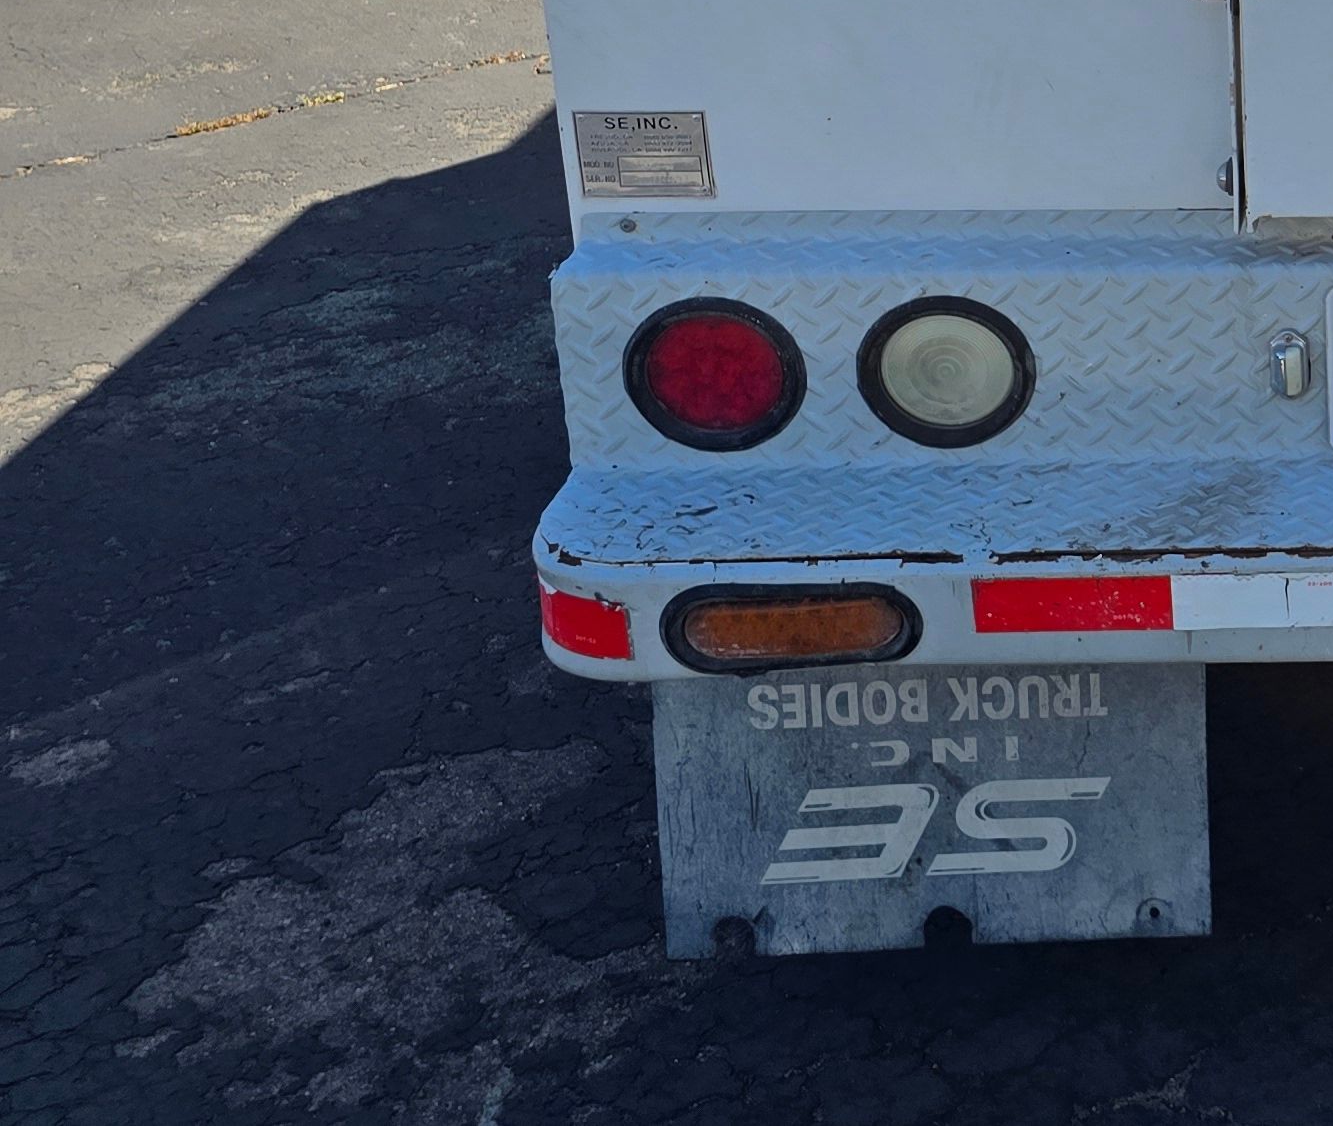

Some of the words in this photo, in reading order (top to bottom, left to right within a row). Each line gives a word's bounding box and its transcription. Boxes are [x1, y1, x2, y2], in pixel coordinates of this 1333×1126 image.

[604, 116, 679, 131] SE,INC.
[747, 678, 929, 731] BODIES
[948, 673, 1109, 721] TRUCK
[849, 735, 1020, 768] INC.
[760, 776, 1112, 885] SE
